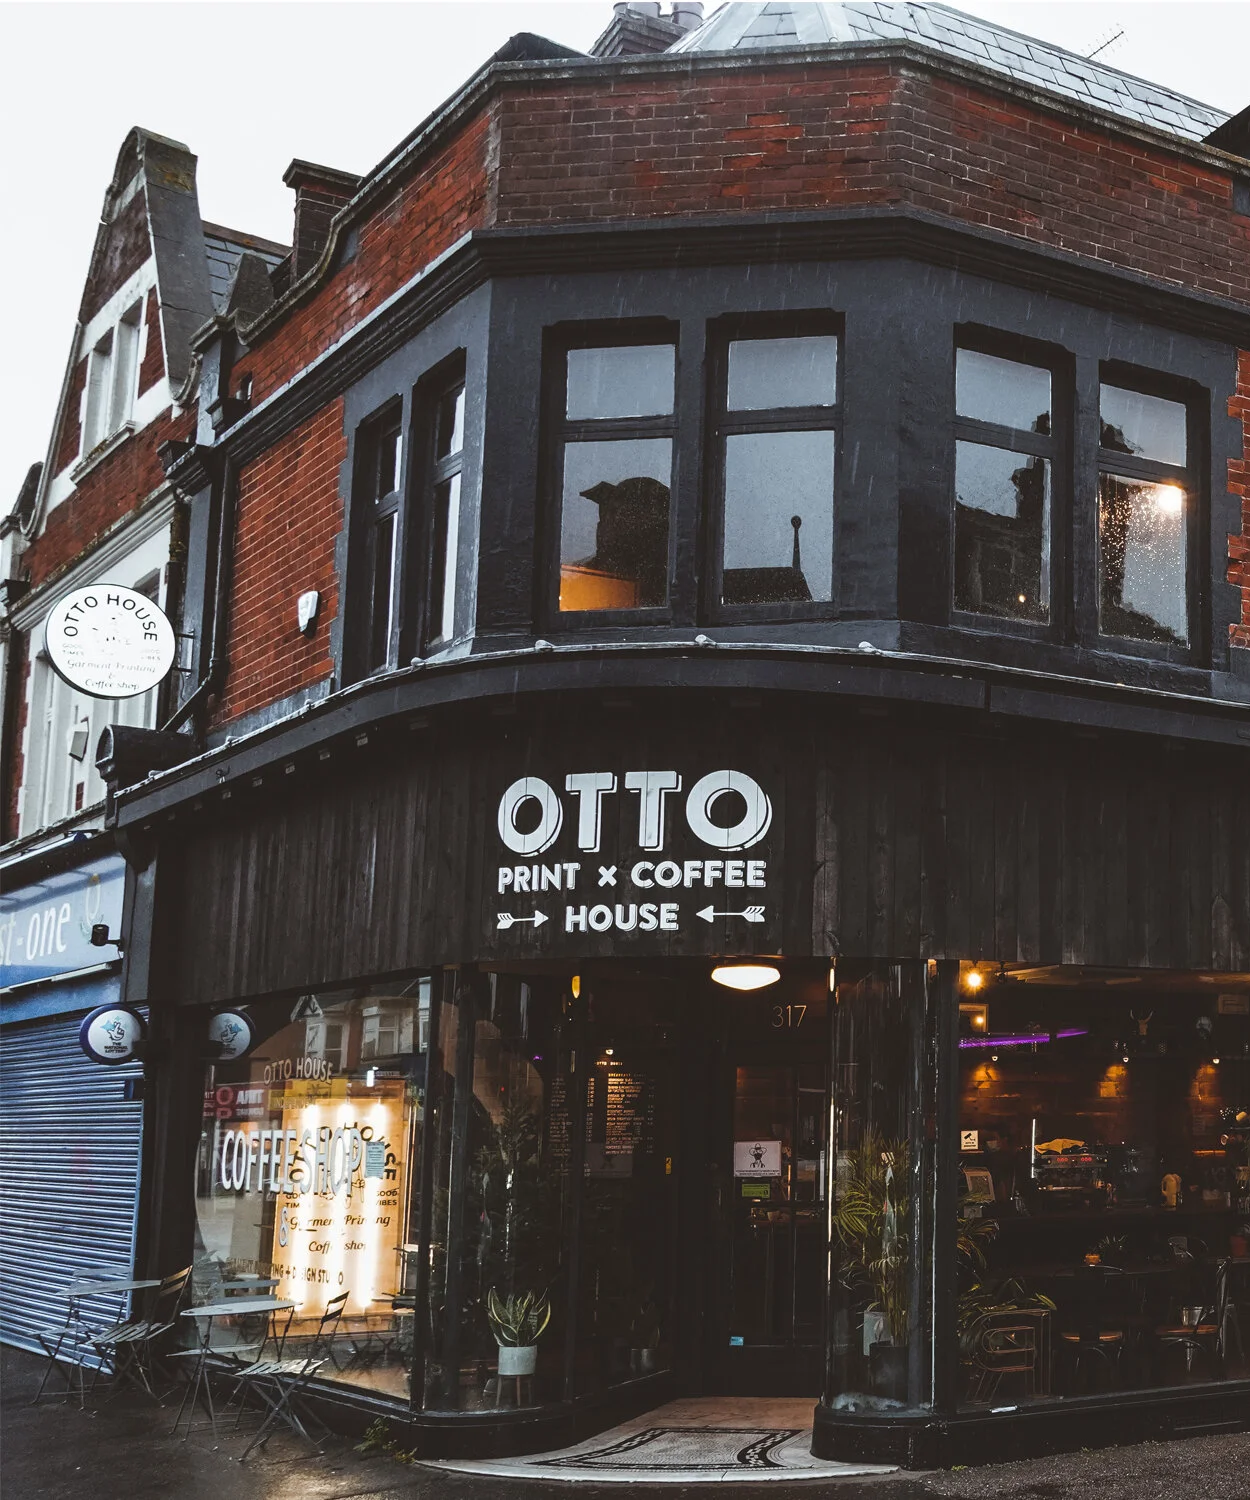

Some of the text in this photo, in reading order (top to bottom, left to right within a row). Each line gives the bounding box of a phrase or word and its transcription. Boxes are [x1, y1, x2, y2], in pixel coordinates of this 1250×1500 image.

[63, 593, 158, 642] OTTO HOUSE
[497, 769, 773, 857] OTTO
[497, 862, 580, 895] PRINT
[630, 860, 767, 888] COFFEE
[564, 902, 680, 933] HOUSE
[770, 1005, 808, 1028] 317
[263, 1057, 333, 1086] OTTO HOUSE
[221, 1129, 298, 1193] COFFEE
[299, 1127, 363, 1198] SHOP
[290, 1214, 391, 1230] Grmen Prinng
[344, 1240, 366, 1252] sho
[292, 1265, 317, 1282] DIGN
[317, 1268, 344, 1286] STUO
